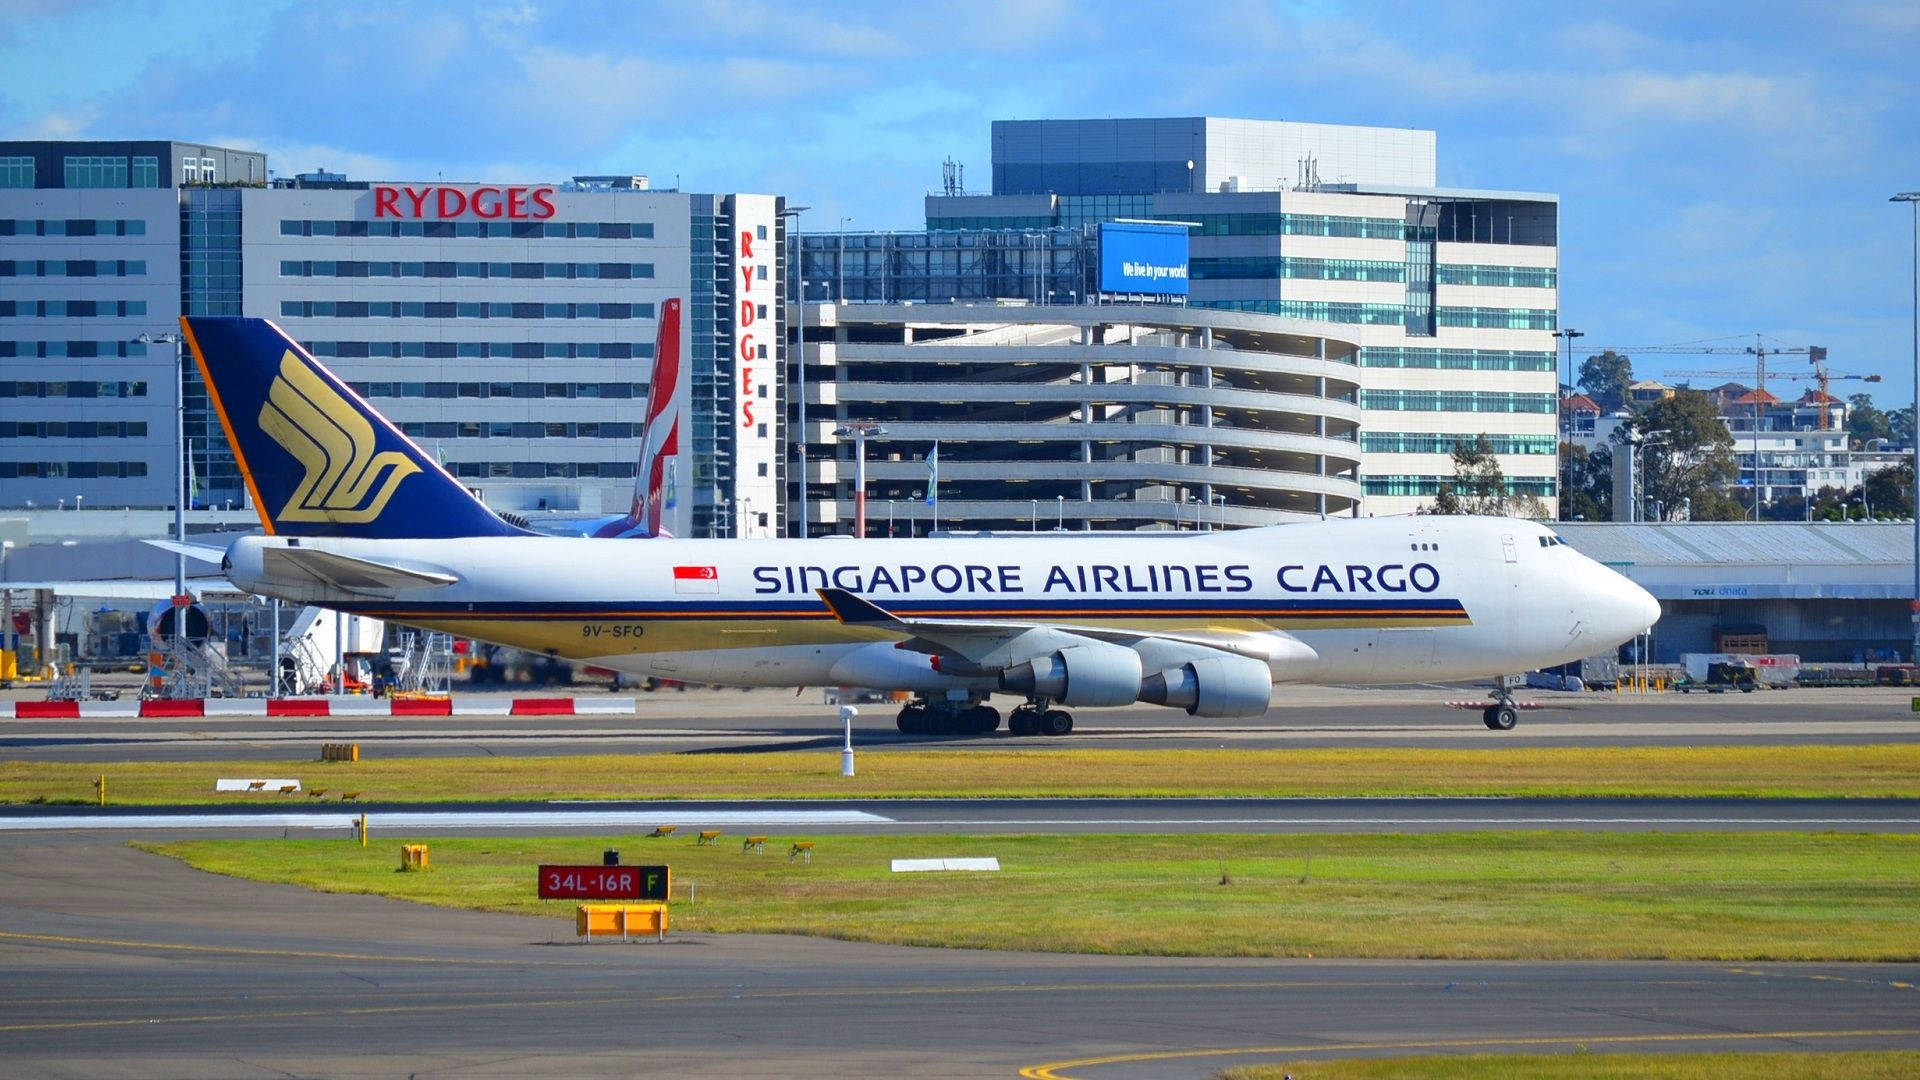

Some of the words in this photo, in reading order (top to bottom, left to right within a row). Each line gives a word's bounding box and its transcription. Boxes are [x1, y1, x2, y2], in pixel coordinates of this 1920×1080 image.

[375, 187, 556, 219] RYDGES
[1123, 262, 1134, 277] We
[1134, 261, 1146, 277] live
[1146, 262, 1154, 278] in
[1153, 266, 1169, 281] your
[1168, 264, 1187, 279] world
[740, 231, 755, 428] RYDGES
[753, 564, 1024, 594] SINGAPORE
[1042, 564, 1254, 593] AIRLINES
[1276, 562, 1441, 593] CARGO
[583, 625, 644, 638] 9V-SFO
[549, 873, 632, 892] 34L-16R
[647, 874, 659, 892] F
